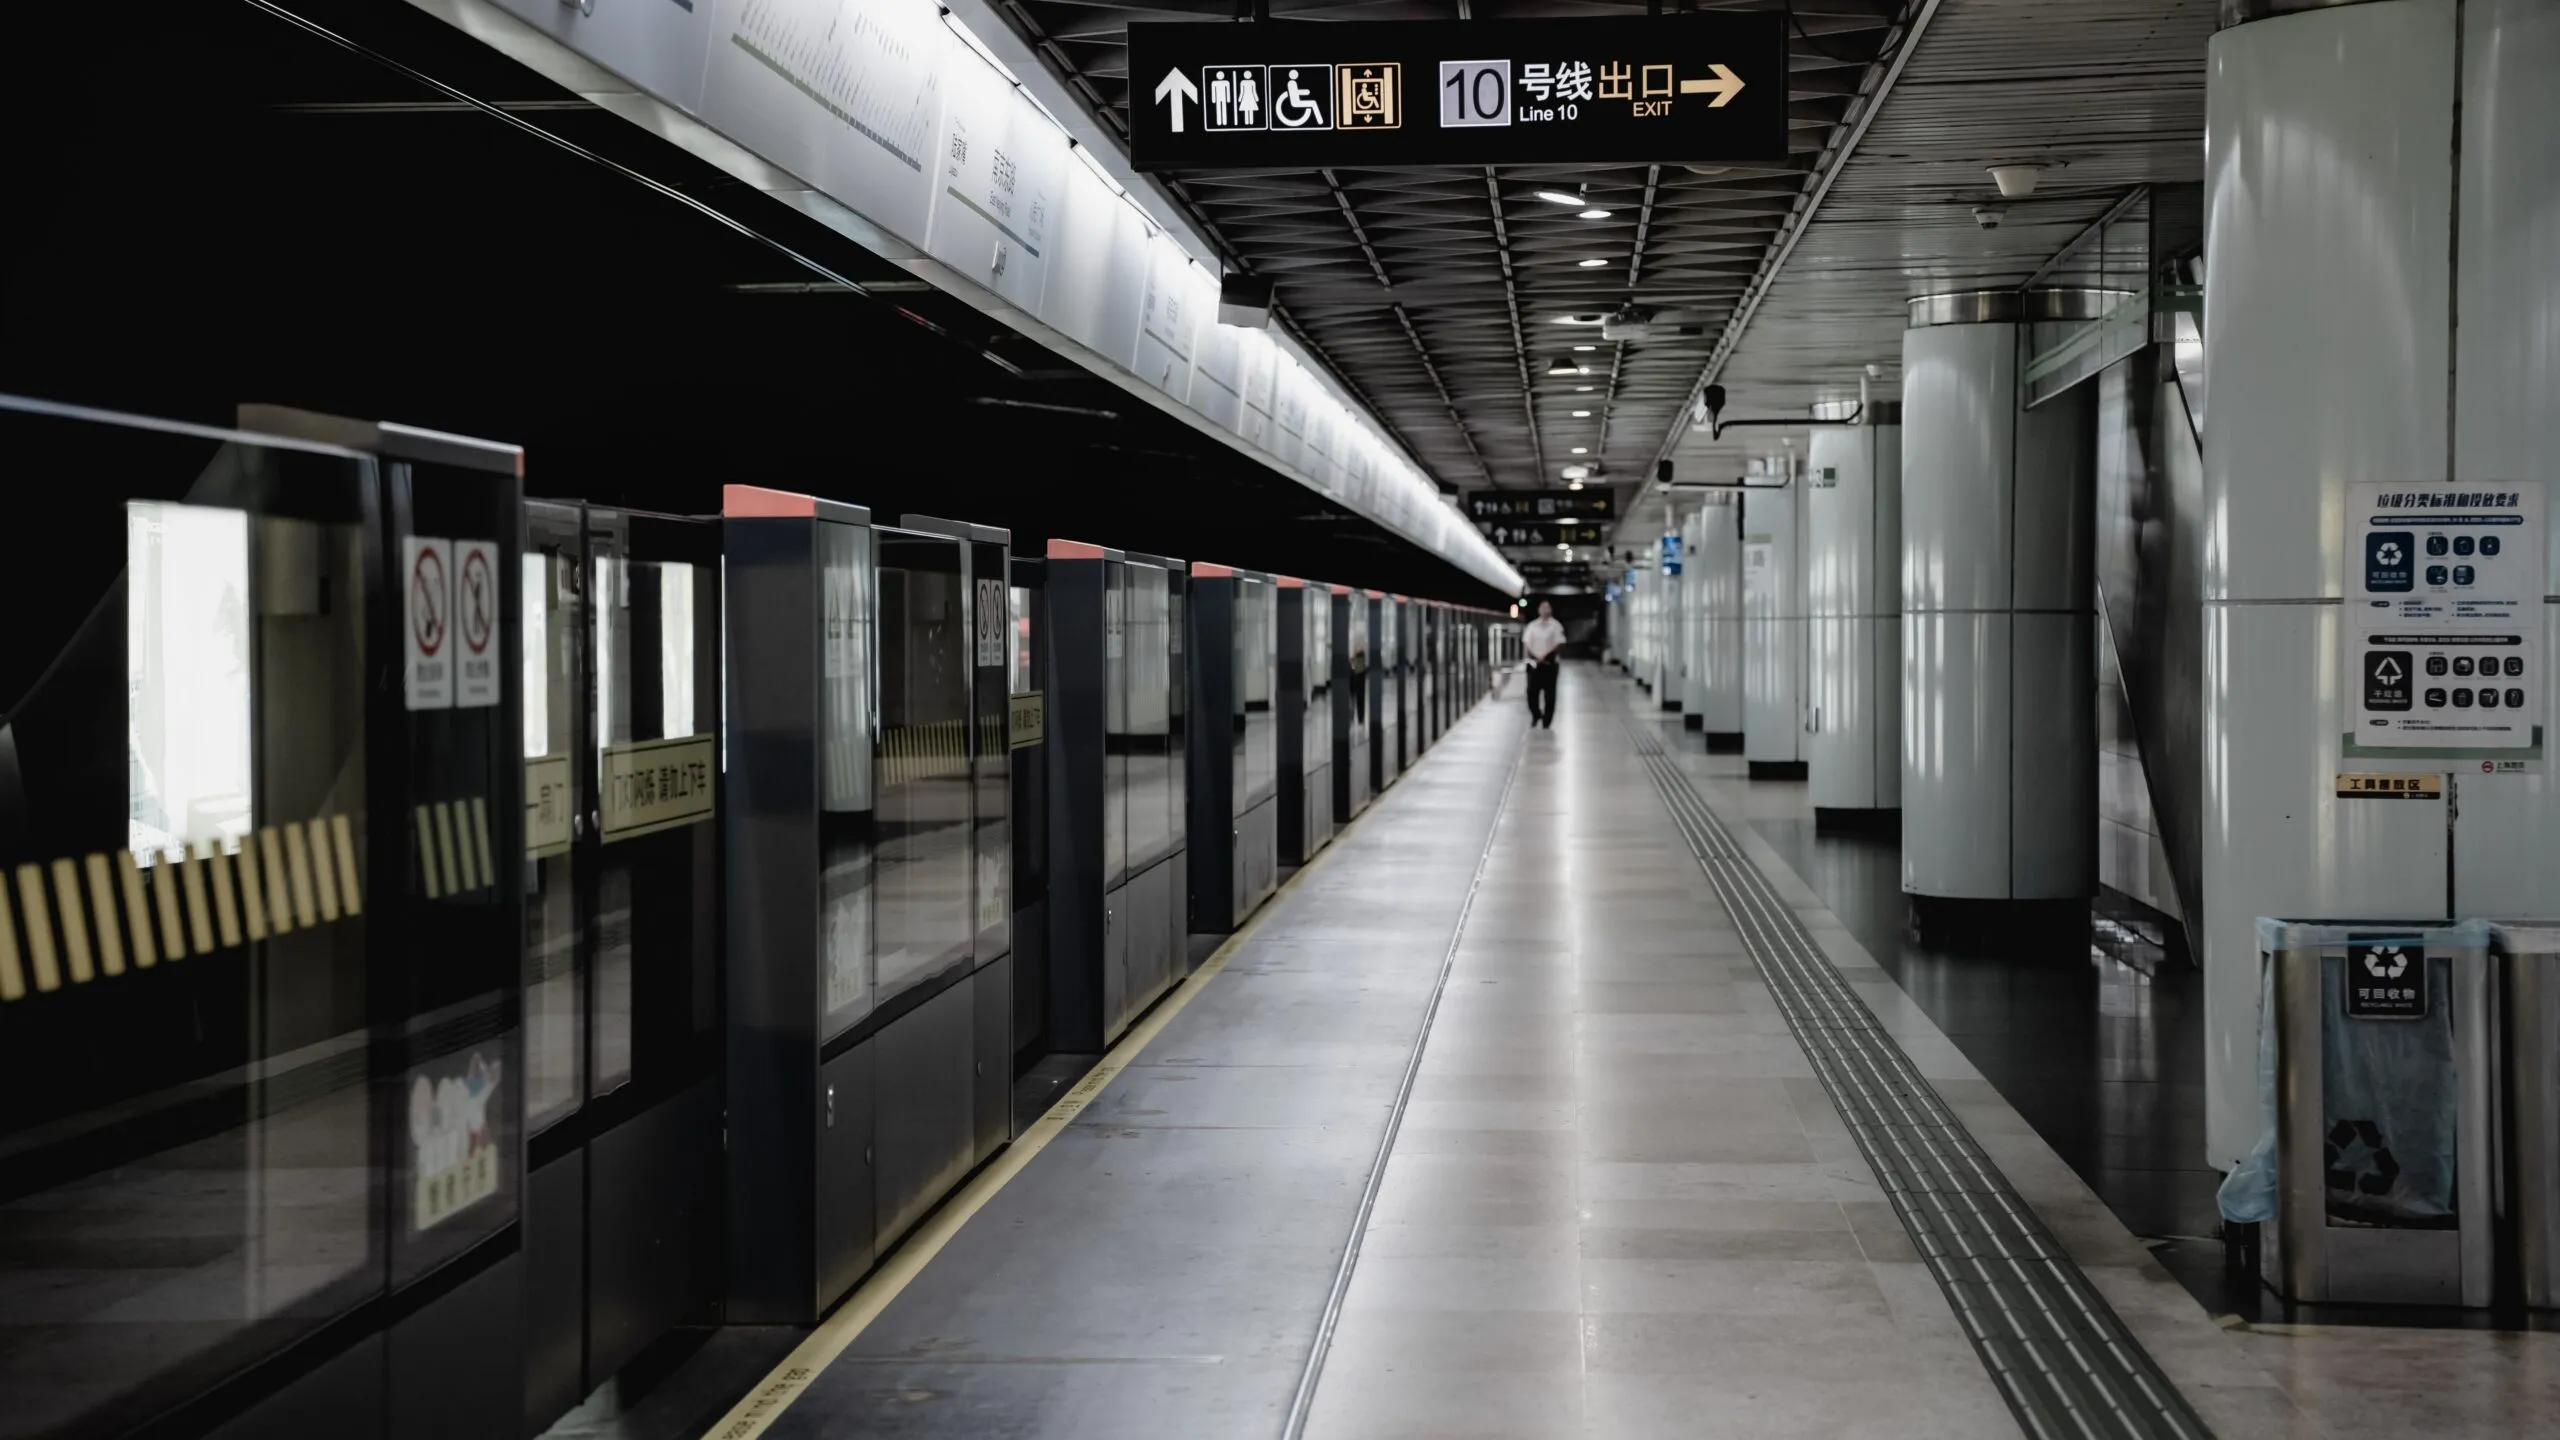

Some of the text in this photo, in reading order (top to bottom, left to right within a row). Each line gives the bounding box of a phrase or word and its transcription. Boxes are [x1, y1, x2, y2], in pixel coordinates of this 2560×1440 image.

[1599, 61, 1673, 100] 出口
[1446, 61, 1593, 120] 10 号线
[1520, 104, 1578, 121] Line 10
[1633, 101, 1673, 117] EXIT
[2357, 988, 2416, 1000] 可回收物
